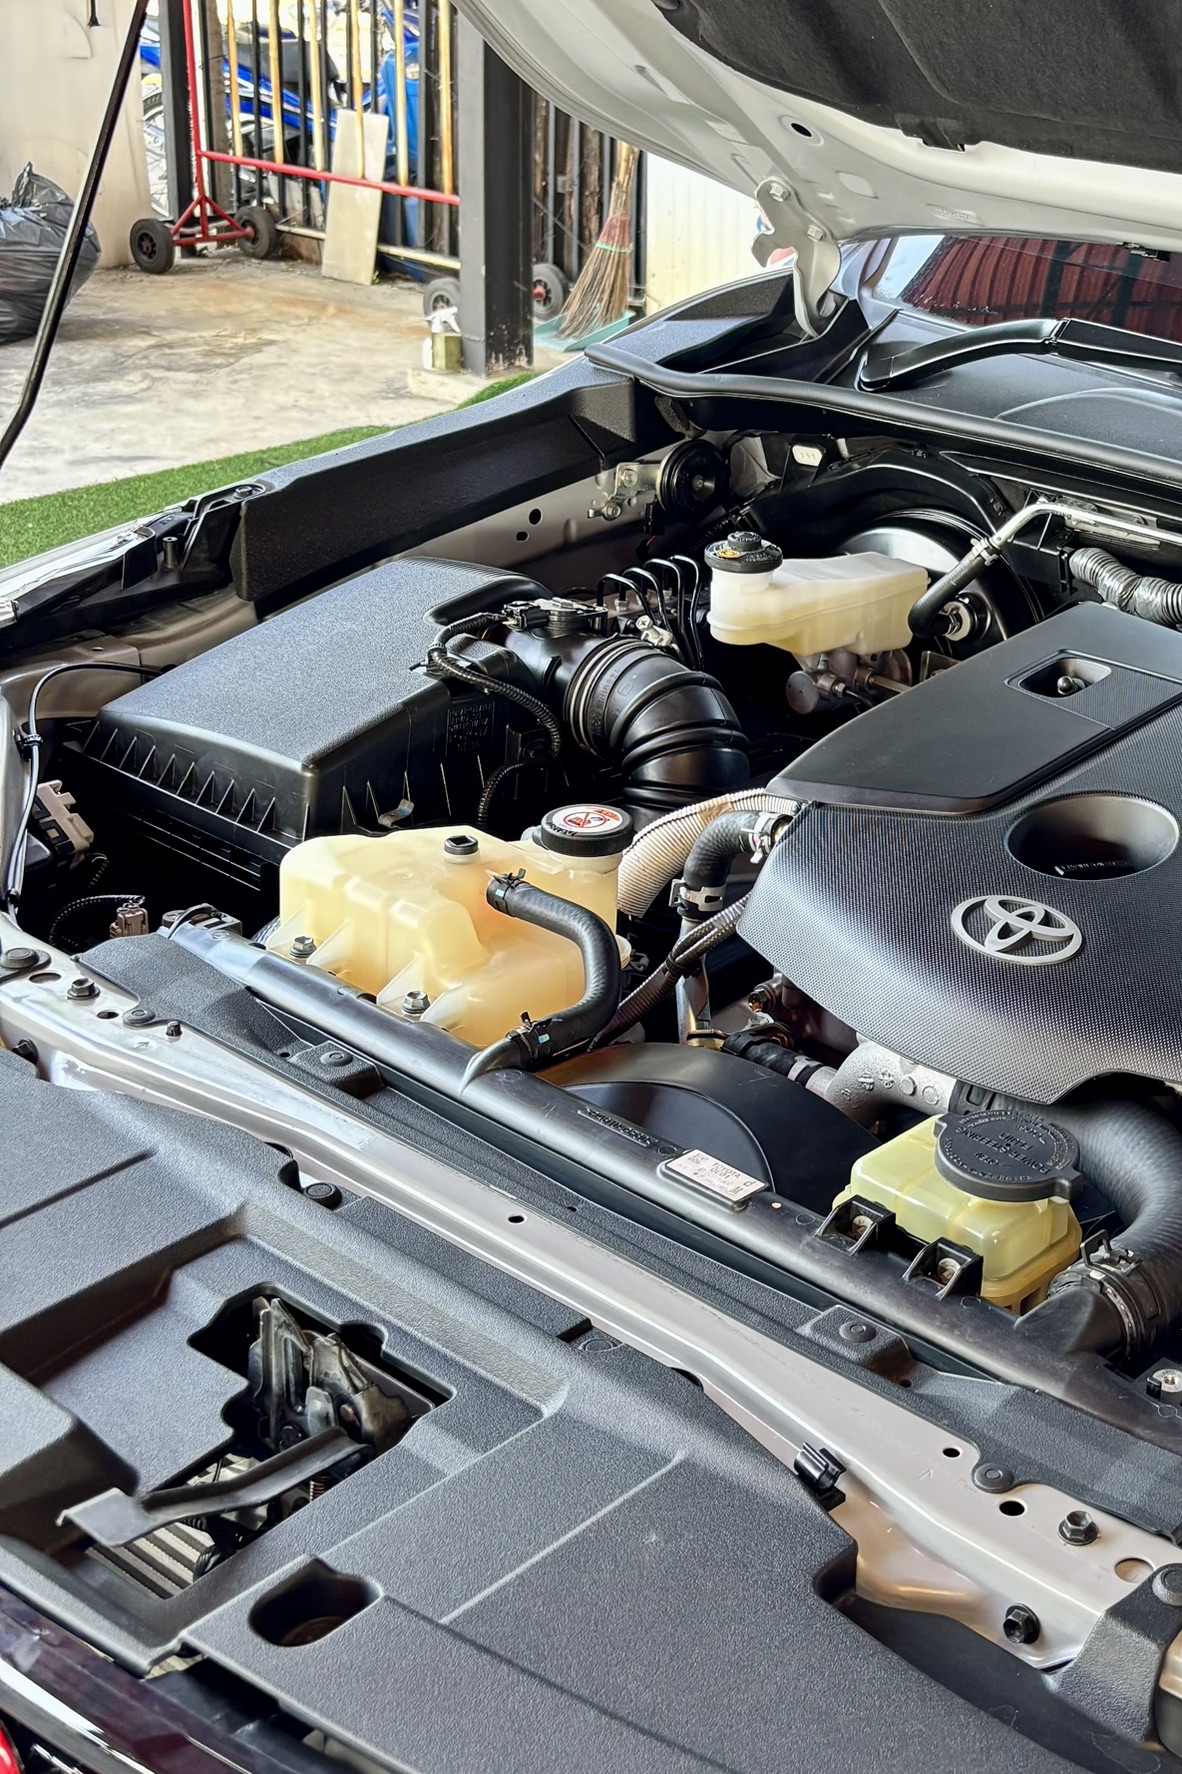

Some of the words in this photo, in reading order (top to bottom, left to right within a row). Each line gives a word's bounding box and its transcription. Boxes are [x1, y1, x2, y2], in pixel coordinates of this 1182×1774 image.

[955, 1127, 1011, 1153] STEERING
[998, 1132, 1034, 1151] FLUID
[712, 1162, 741, 1179] TOYOTA
[1008, 1149, 1052, 1174] POWER
